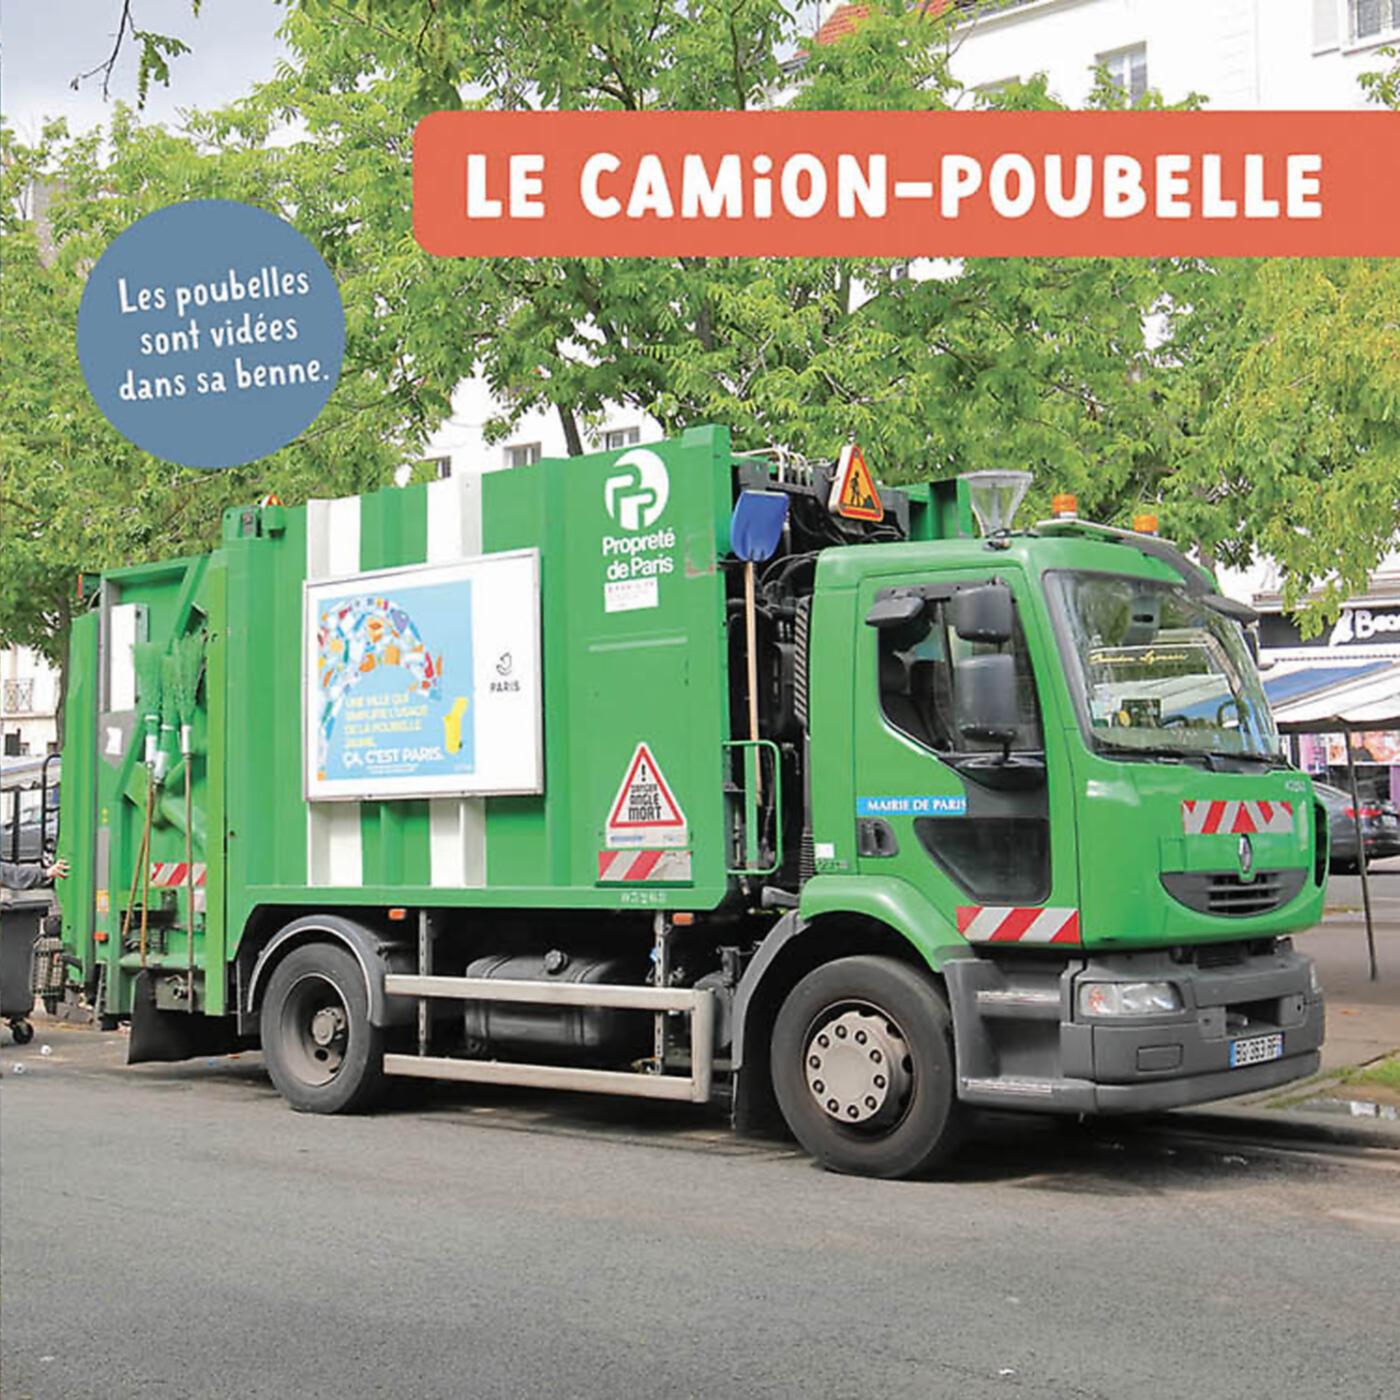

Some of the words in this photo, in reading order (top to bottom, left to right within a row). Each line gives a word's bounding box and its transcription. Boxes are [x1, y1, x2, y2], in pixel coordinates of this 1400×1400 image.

[602, 527, 676, 557] Propreté
[607, 560, 629, 580] de
[631, 553, 674, 577] Paris
[490, 681, 520, 693] PARIS
[867, 799, 910, 811] MAIRIE
[912, 799, 931, 811] DE
[932, 797, 967, 810] PARIS
